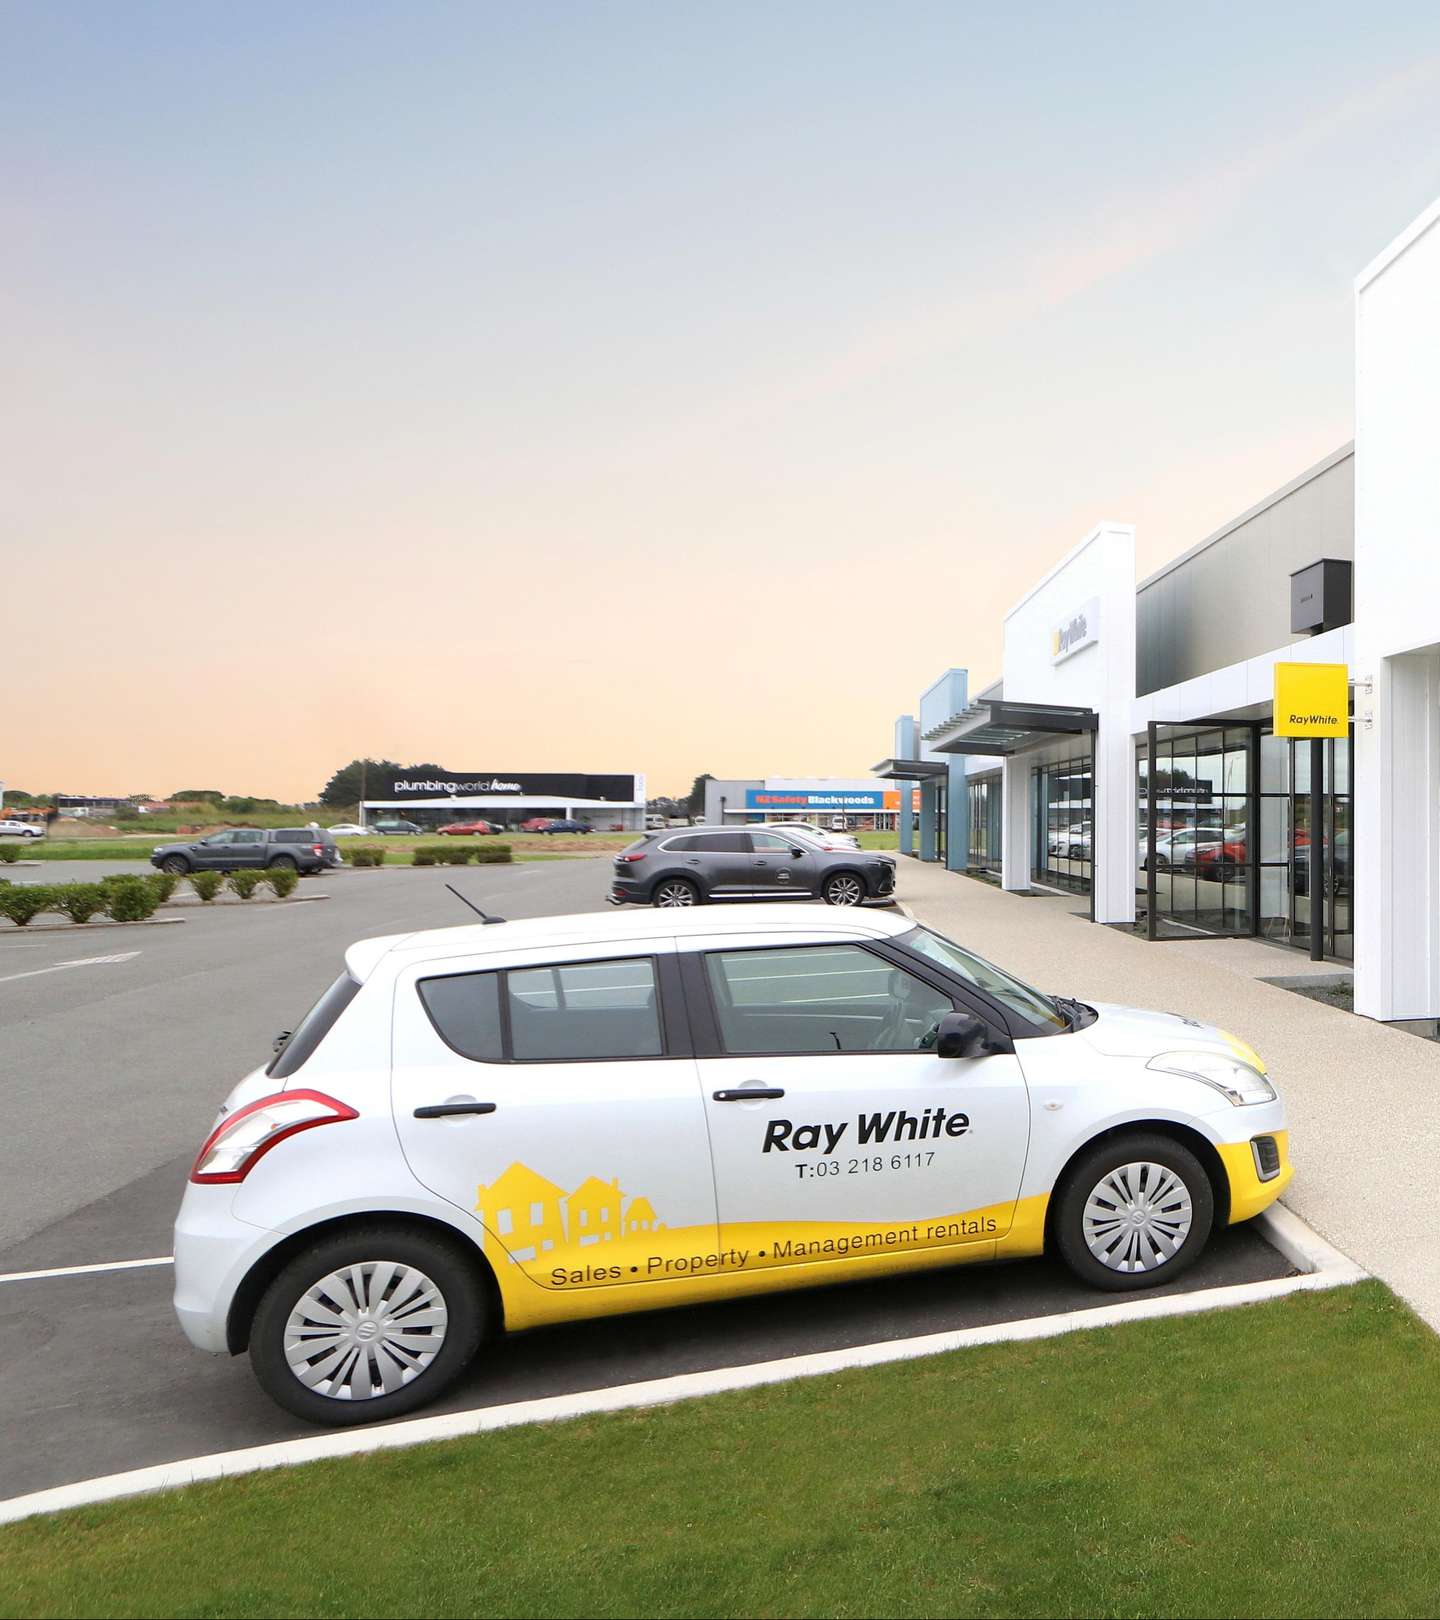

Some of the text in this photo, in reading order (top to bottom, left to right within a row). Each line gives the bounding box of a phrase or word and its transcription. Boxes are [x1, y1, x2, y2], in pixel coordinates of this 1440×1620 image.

[762, 1107, 970, 1155] Ray White
[847, 1156, 884, 1174] 218
[890, 1151, 936, 1170] 6117
[551, 1215, 998, 1286] Sales Property Management rentals
